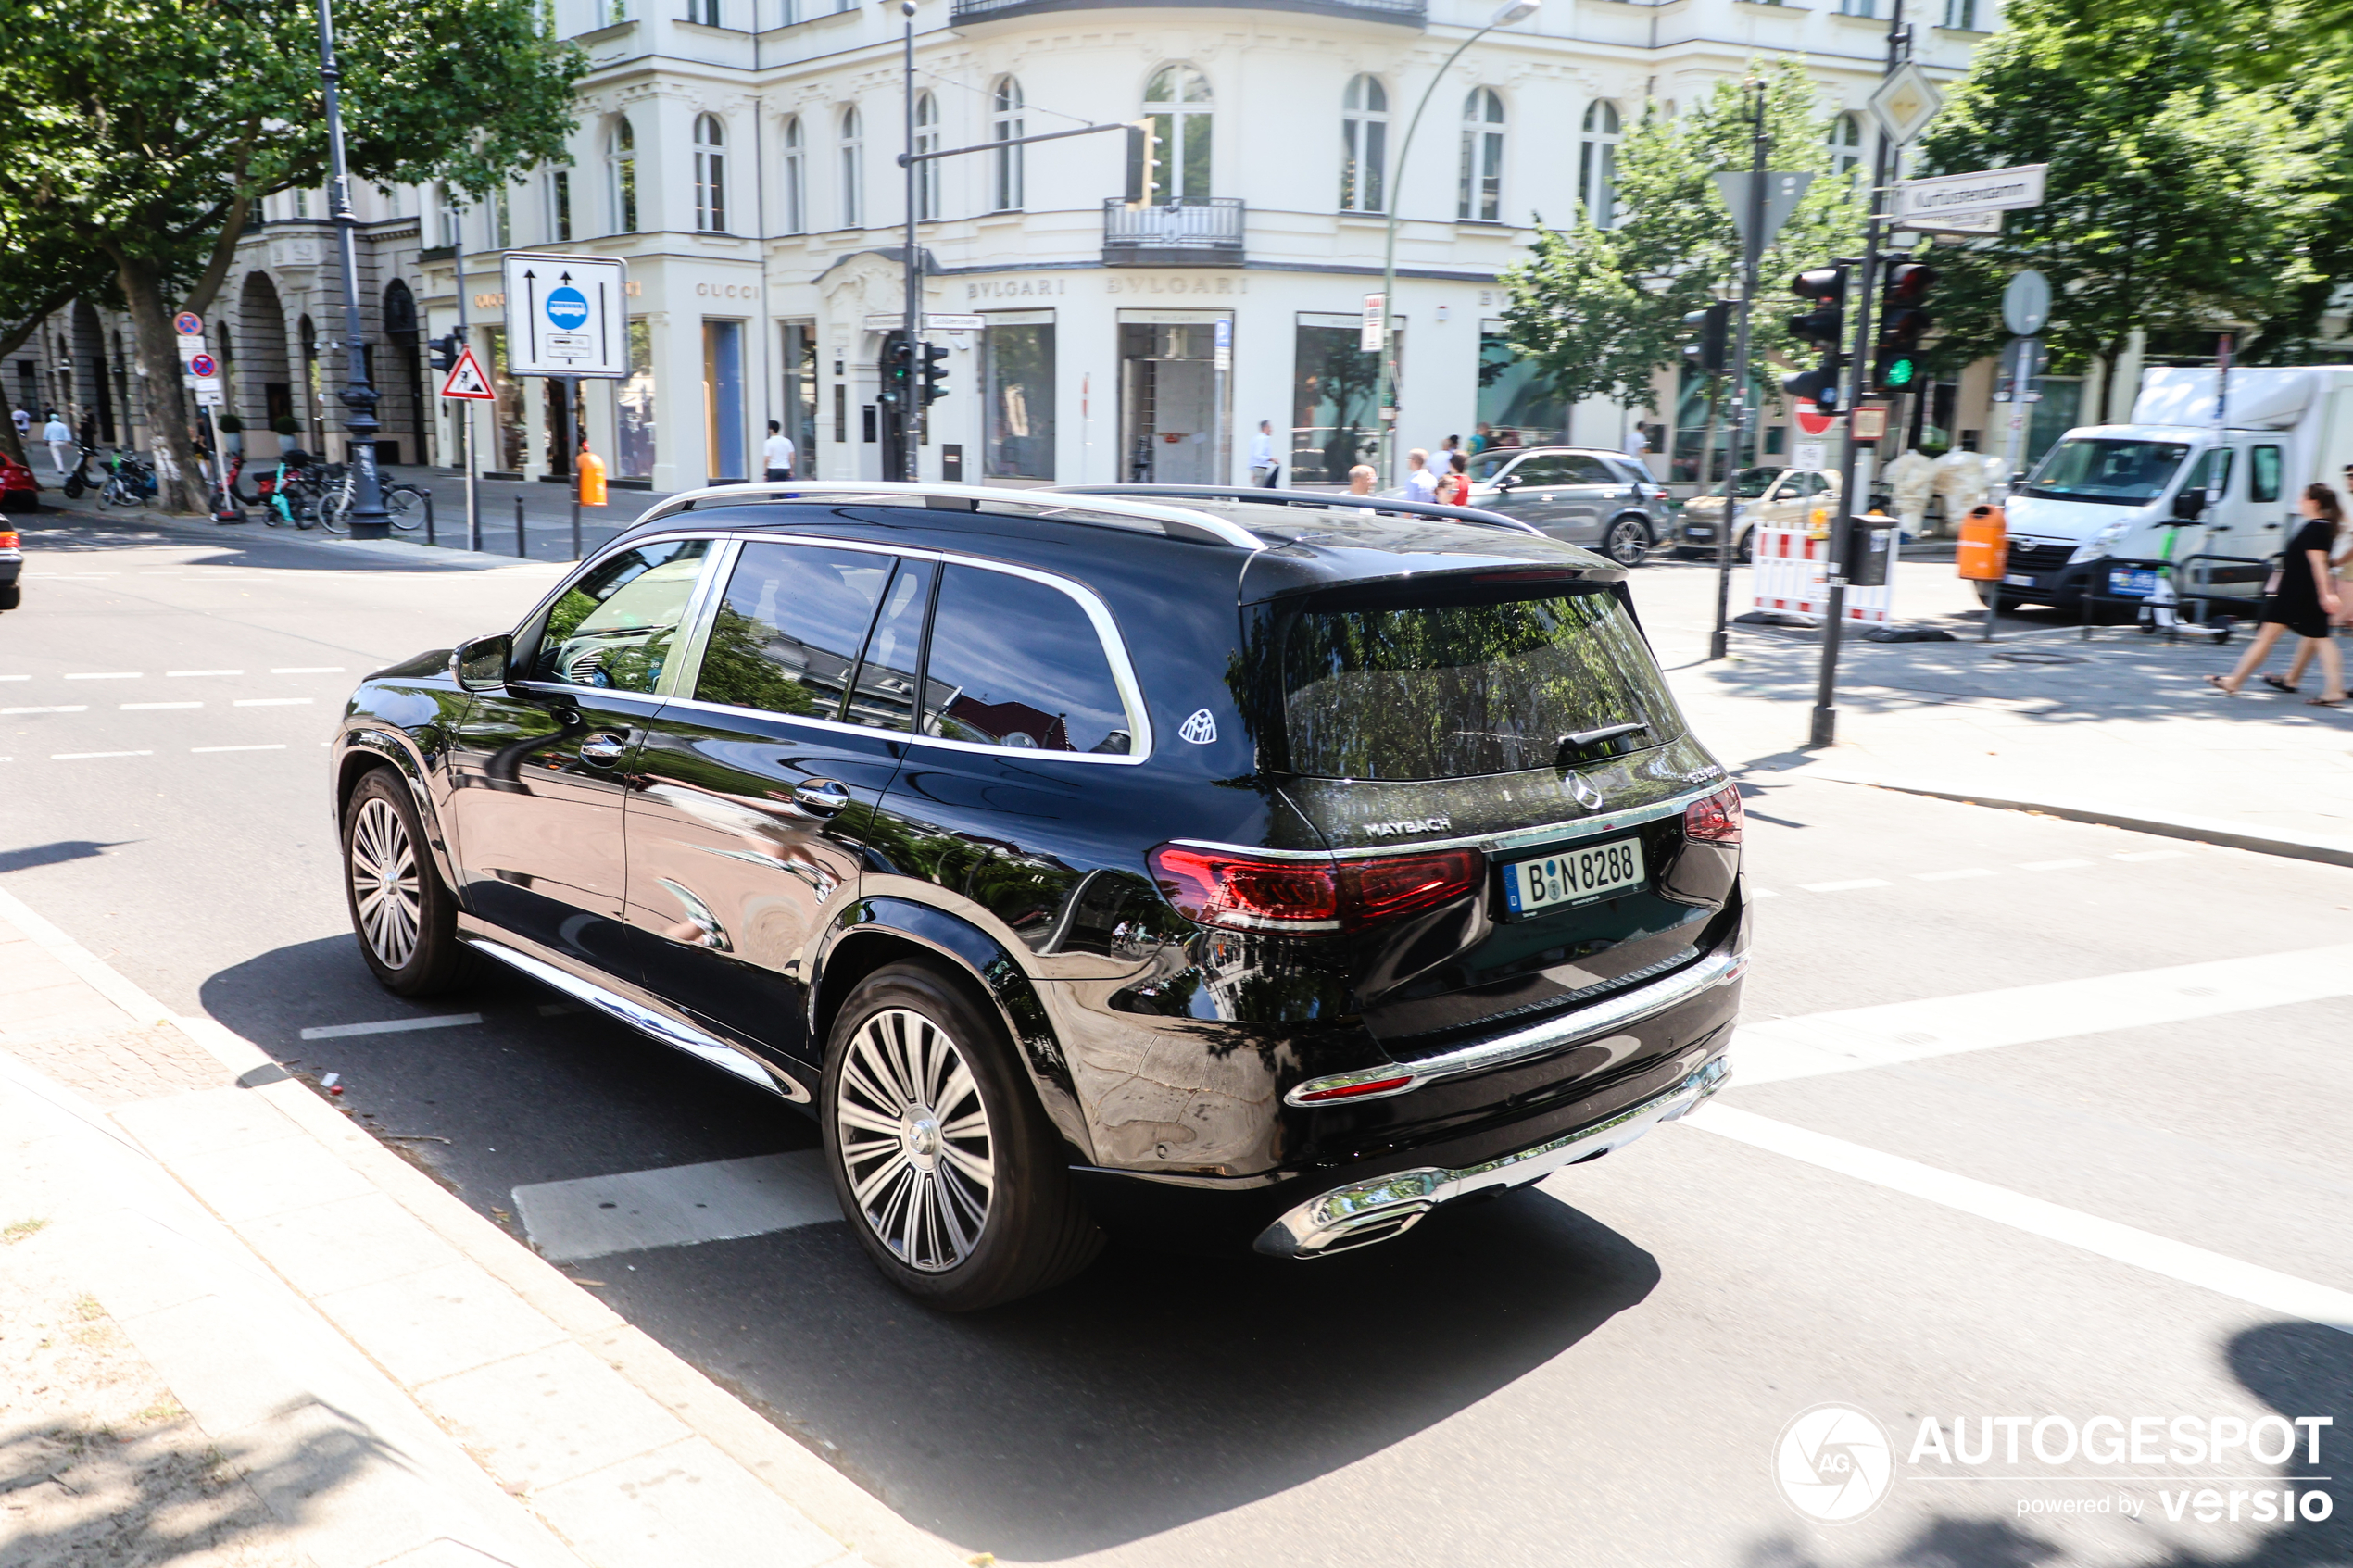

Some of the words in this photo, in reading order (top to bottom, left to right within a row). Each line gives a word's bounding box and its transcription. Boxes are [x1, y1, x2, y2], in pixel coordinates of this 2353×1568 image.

[696, 282, 761, 299] GUCCI
[966, 278, 1066, 299] BVLGARI
[1104, 277, 1249, 295] BVLGARI
[1363, 817, 1453, 838] MAYBACH
[1529, 864, 1545, 902] B
[1560, 857, 1578, 895] N
[1580, 845, 1634, 889] 8288
[1510, 895, 1518, 907] D
